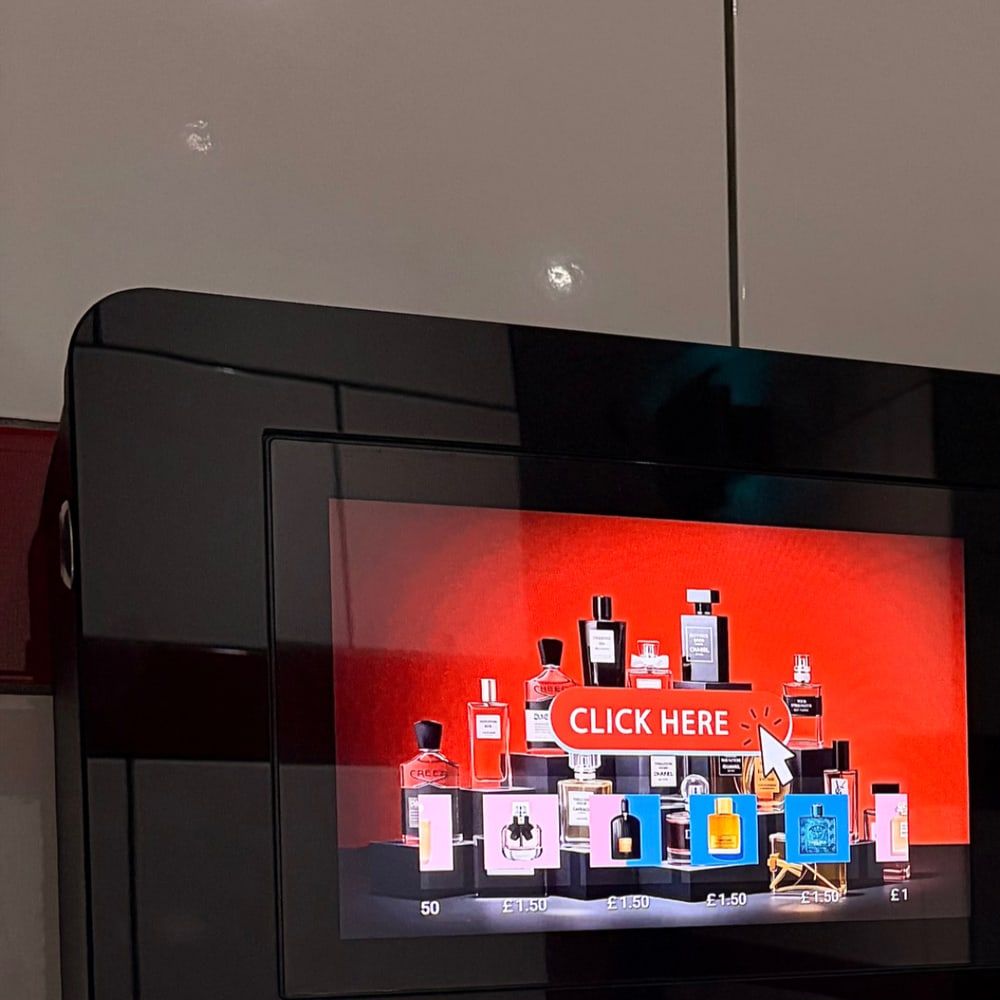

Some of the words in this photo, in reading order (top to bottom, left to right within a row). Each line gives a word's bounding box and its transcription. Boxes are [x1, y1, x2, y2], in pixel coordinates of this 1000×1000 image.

[569, 707, 652, 734] CLICK
[661, 709, 729, 736] HERE
[706, 892, 747, 907] £1.50
[890, 888, 908, 901] £1
[420, 900, 440, 915] 50
